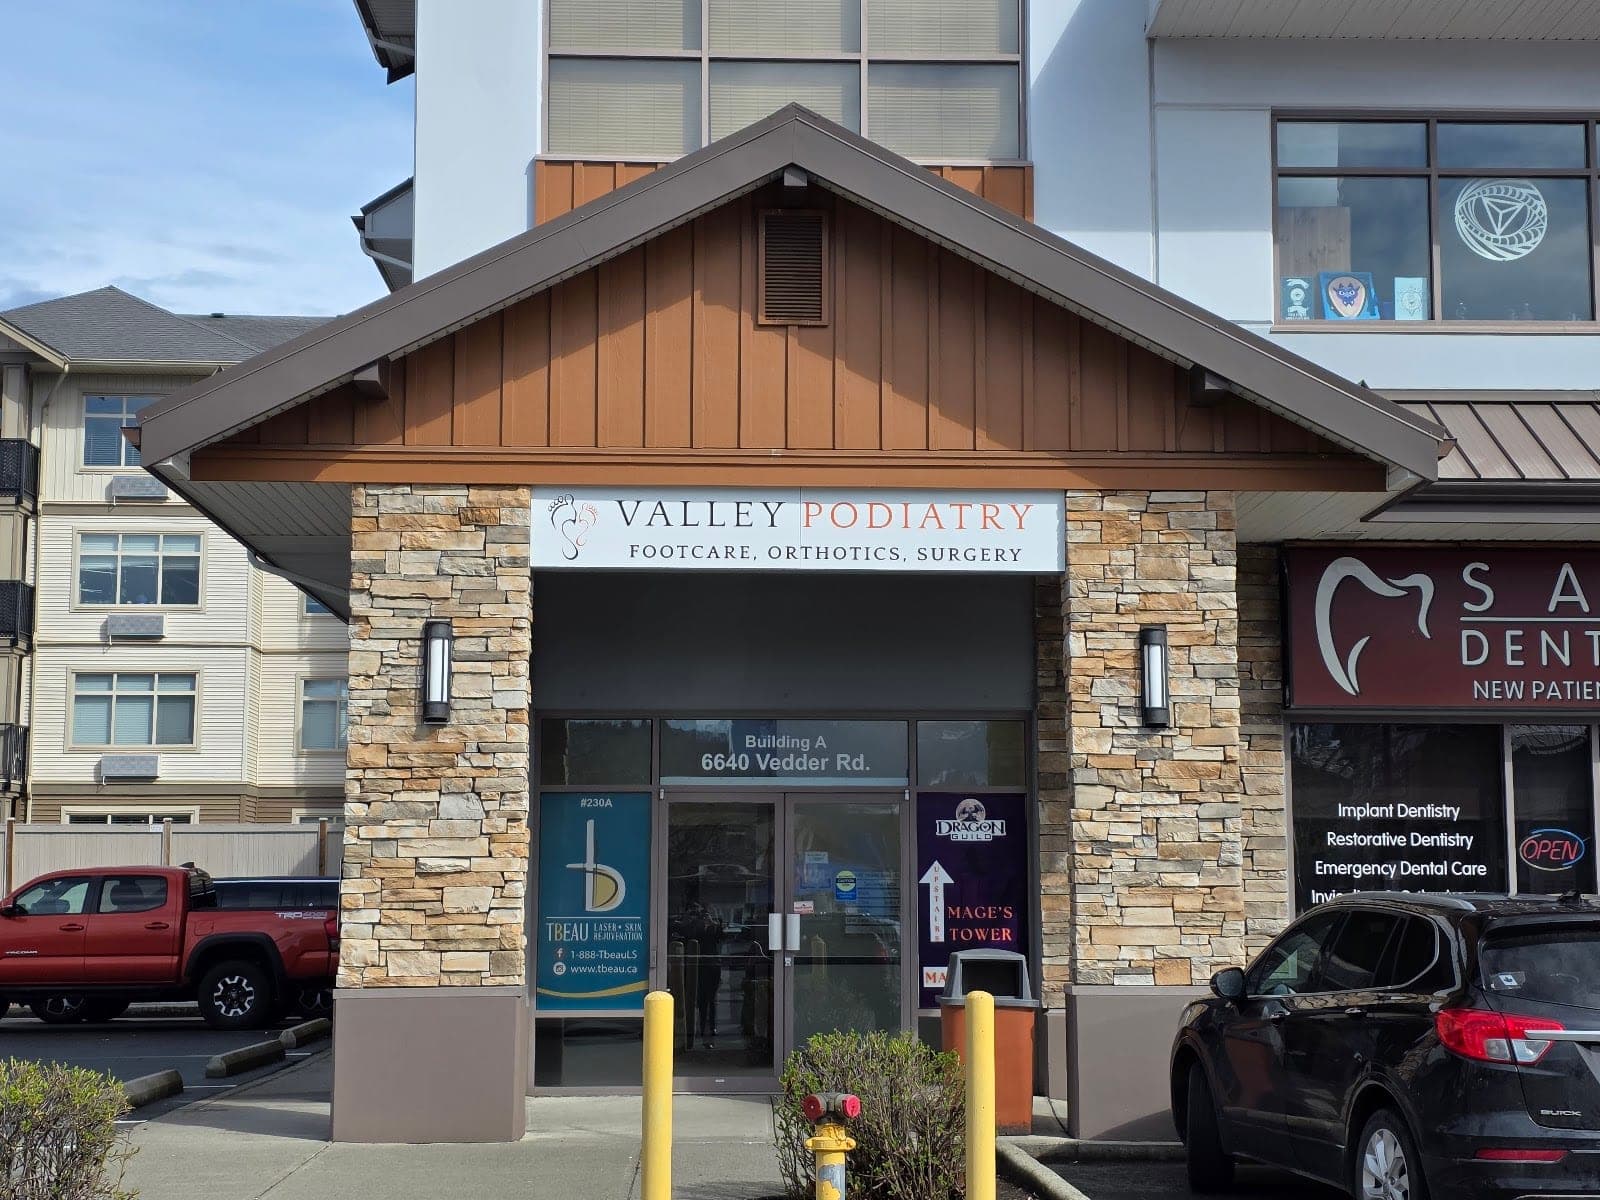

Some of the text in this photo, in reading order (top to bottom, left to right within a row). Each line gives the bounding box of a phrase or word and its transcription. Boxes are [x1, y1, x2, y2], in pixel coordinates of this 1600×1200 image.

[615, 500, 1033, 530] VALLEY PODIATRY
[629, 545, 1022, 563] FOOTCARE, ORTHOTICS, SURGERY
[1475, 680, 1524, 700] NEW
[746, 735, 827, 751] Building A
[701, 753, 870, 771] 6640 Vedder Rd.
[580, 798, 613, 808] #230A
[1338, 803, 1461, 822] Implant Dentistry
[938, 821, 1004, 834] DRAGON
[1327, 832, 1474, 852] Restorative Dentistry
[1523, 840, 1578, 860] OPEN
[1315, 860, 1487, 879] Emergency Dental Care
[948, 906, 1013, 919] MAGE'S
[546, 922, 589, 942] TBEAU
[625, 923, 642, 932] SKIN
[949, 928, 1013, 942] TOWER
[571, 964, 638, 974] www.tbeau.ca
